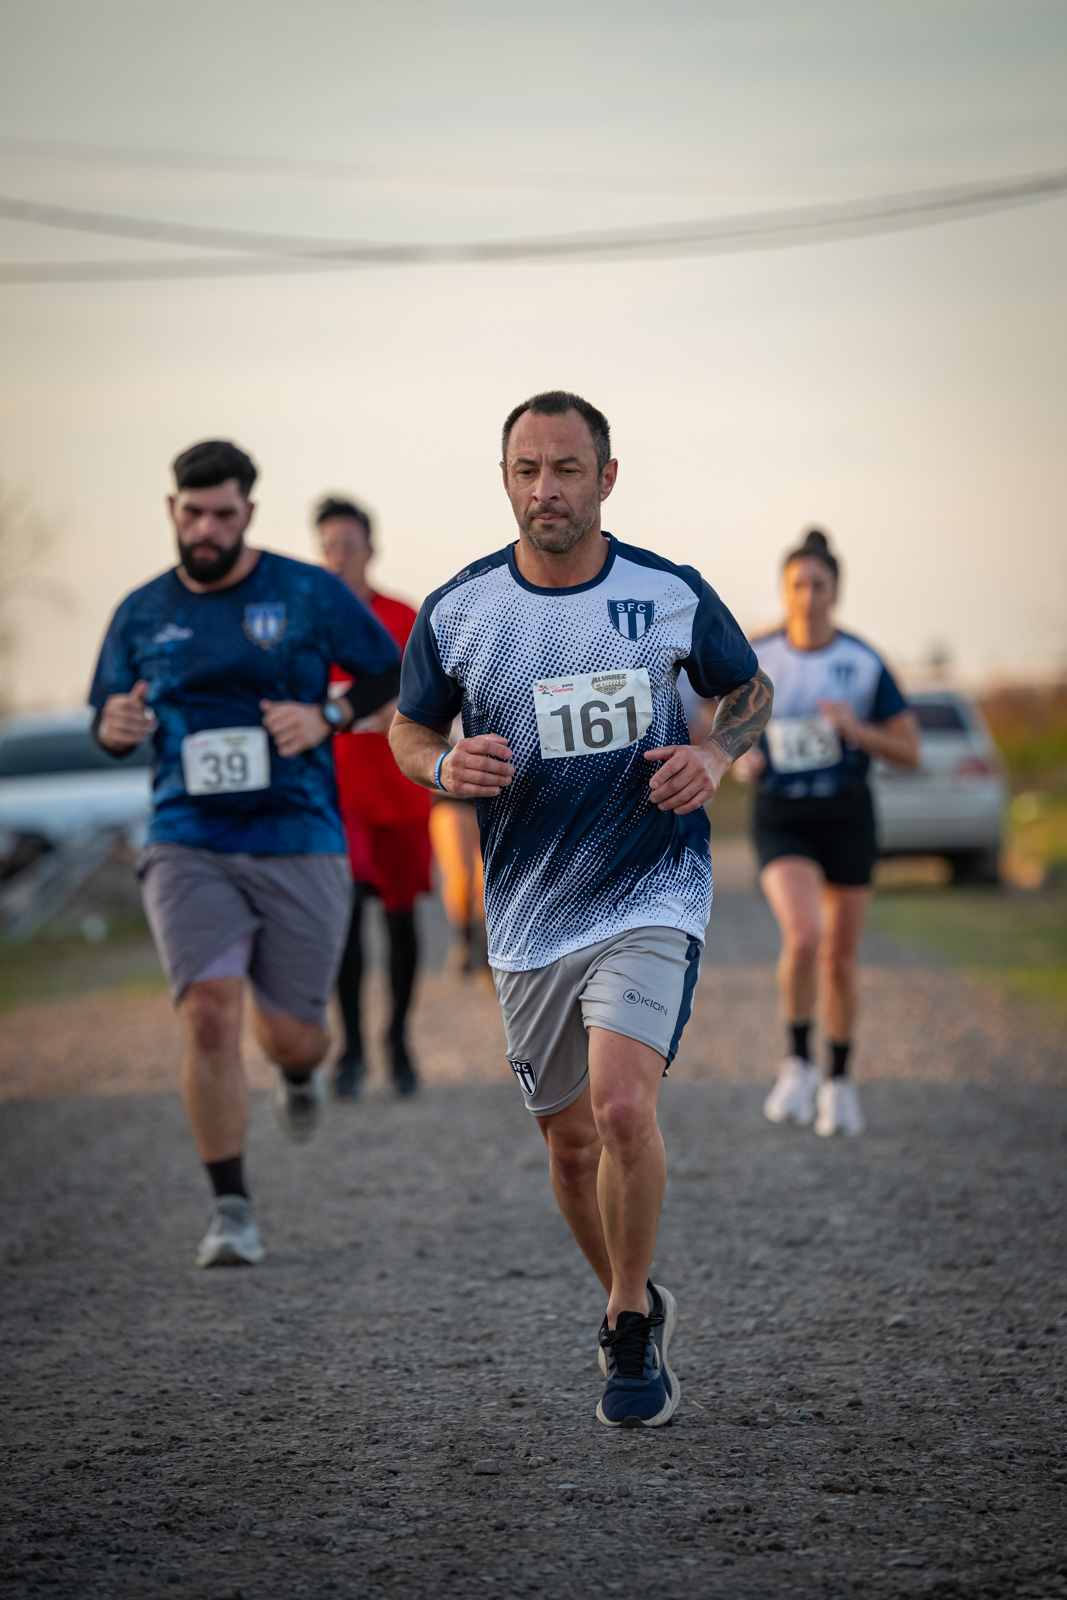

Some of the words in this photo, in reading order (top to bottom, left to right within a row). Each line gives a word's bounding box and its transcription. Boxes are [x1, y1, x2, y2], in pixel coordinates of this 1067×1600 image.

[616, 603, 646, 613] SFC
[592, 674, 627, 683] ALVAREZ
[594, 680, 627, 689] CORRE
[550, 696, 638, 752] 161
[201, 752, 249, 787] 39
[641, 997, 668, 1015] KION
[512, 1062, 529, 1071] SFC
